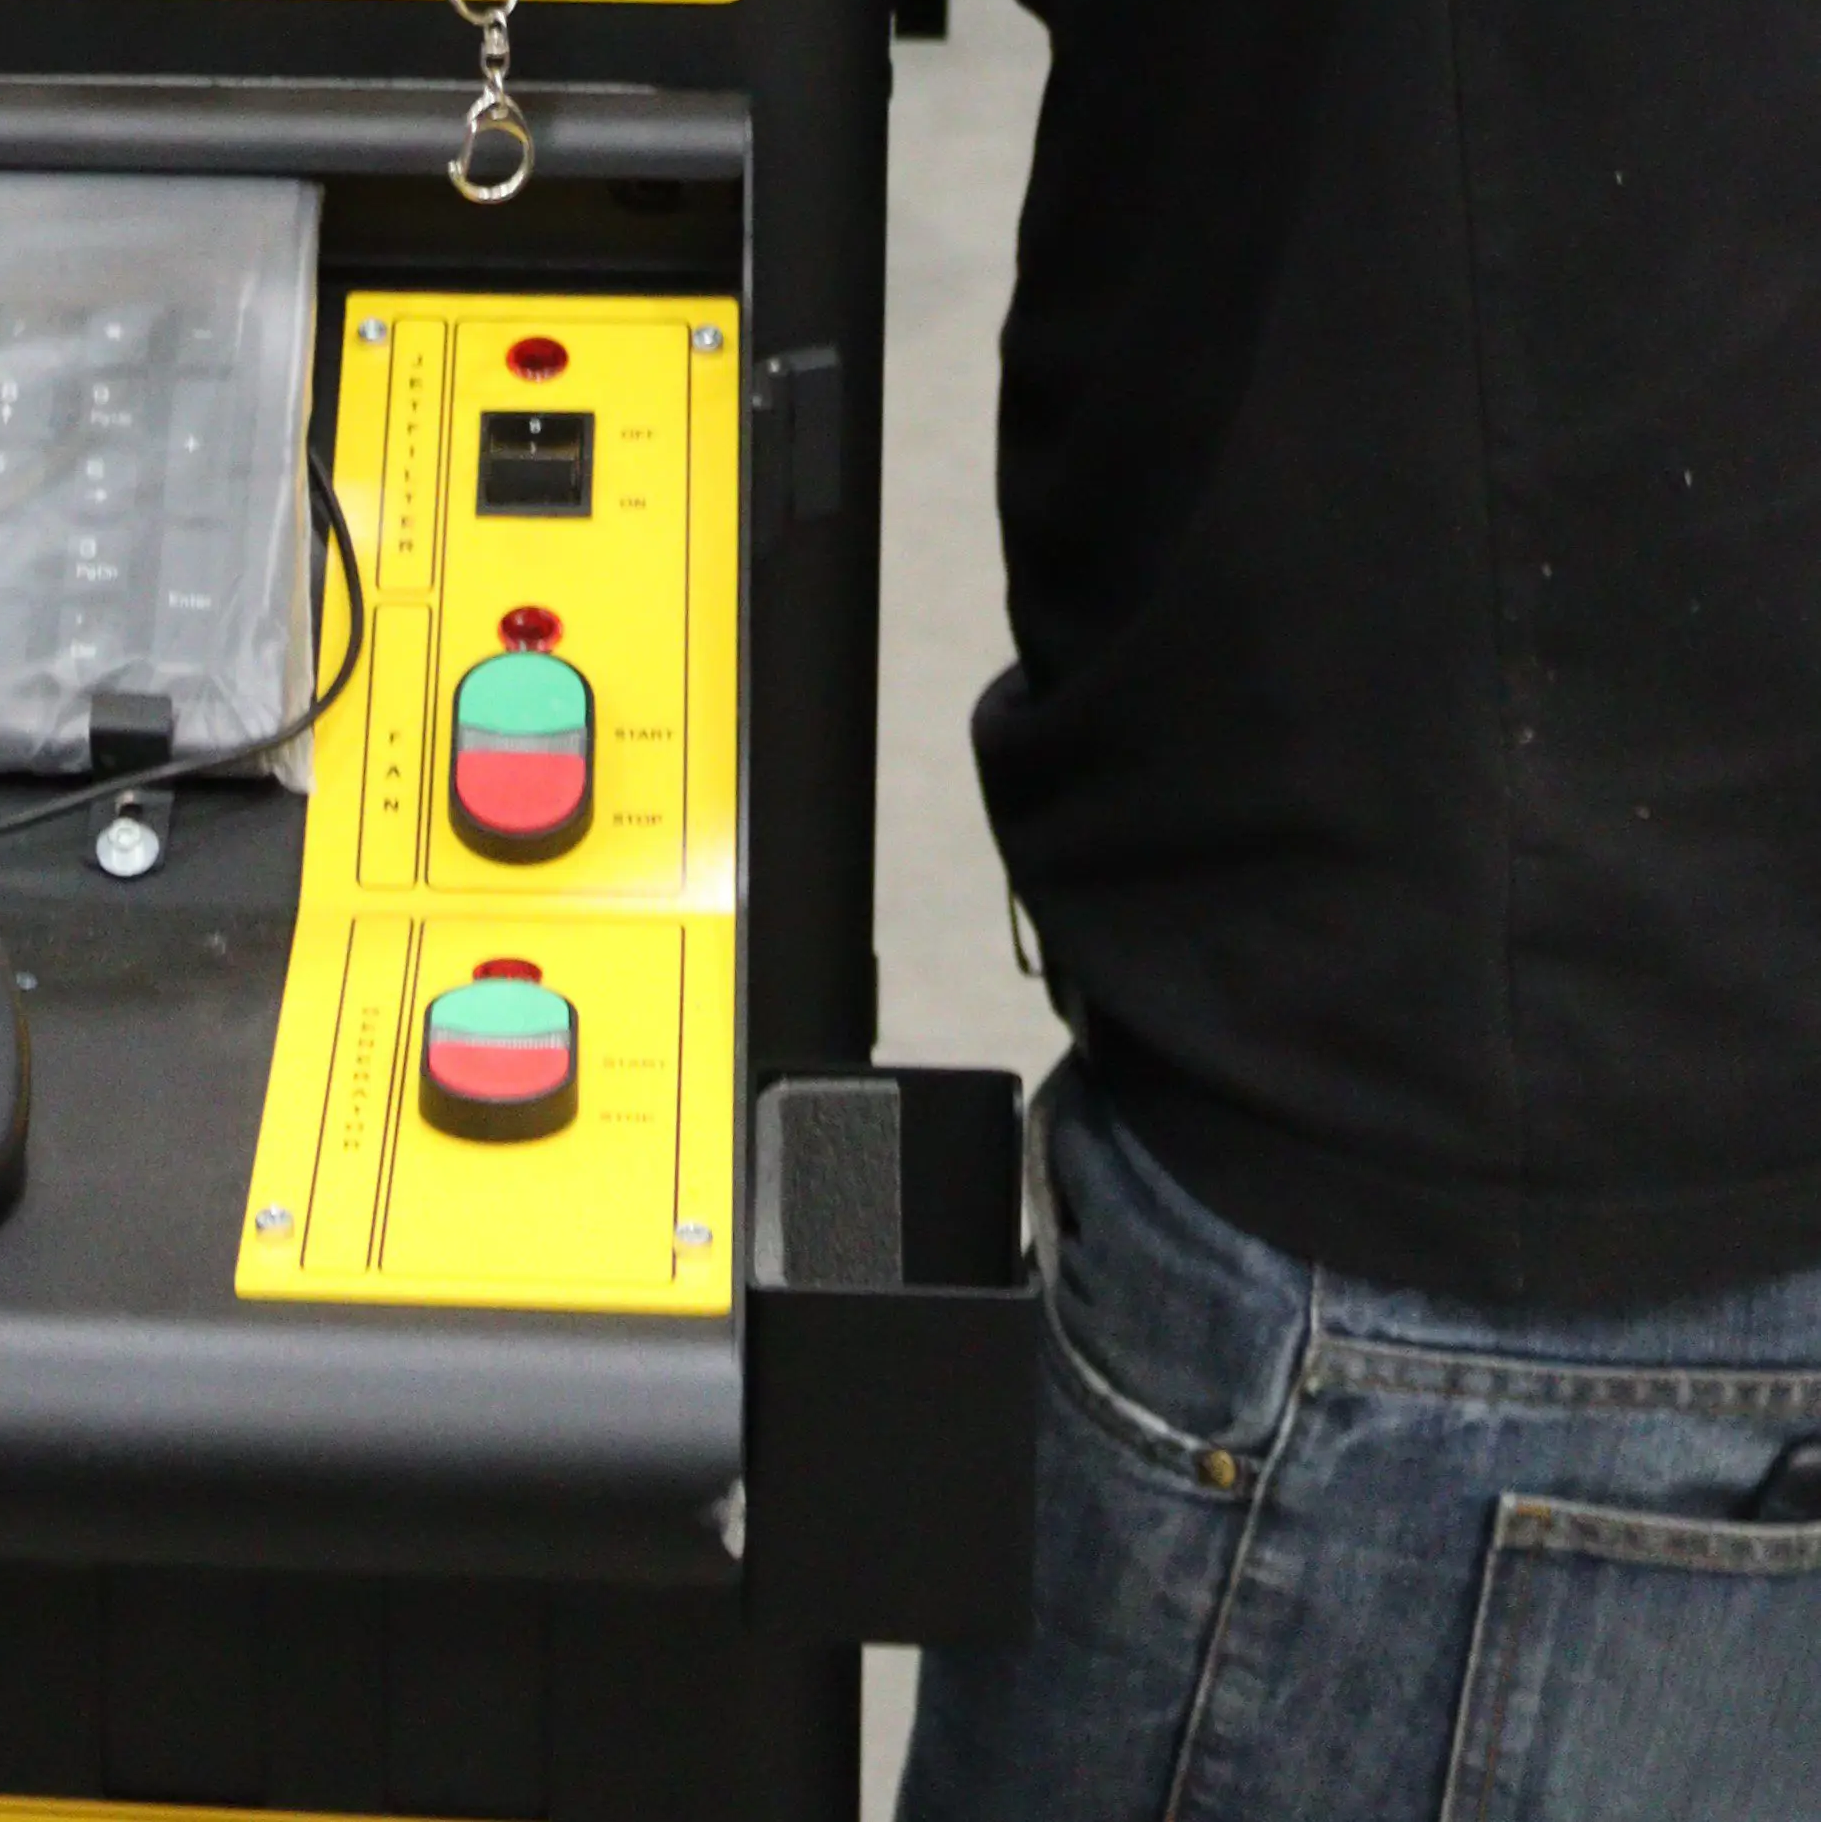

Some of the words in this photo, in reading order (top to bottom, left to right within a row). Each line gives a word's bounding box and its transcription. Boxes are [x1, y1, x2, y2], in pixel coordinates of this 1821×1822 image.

[614, 727, 674, 741] START
[383, 731, 400, 813] FAN
[612, 813, 663, 827] STOP
